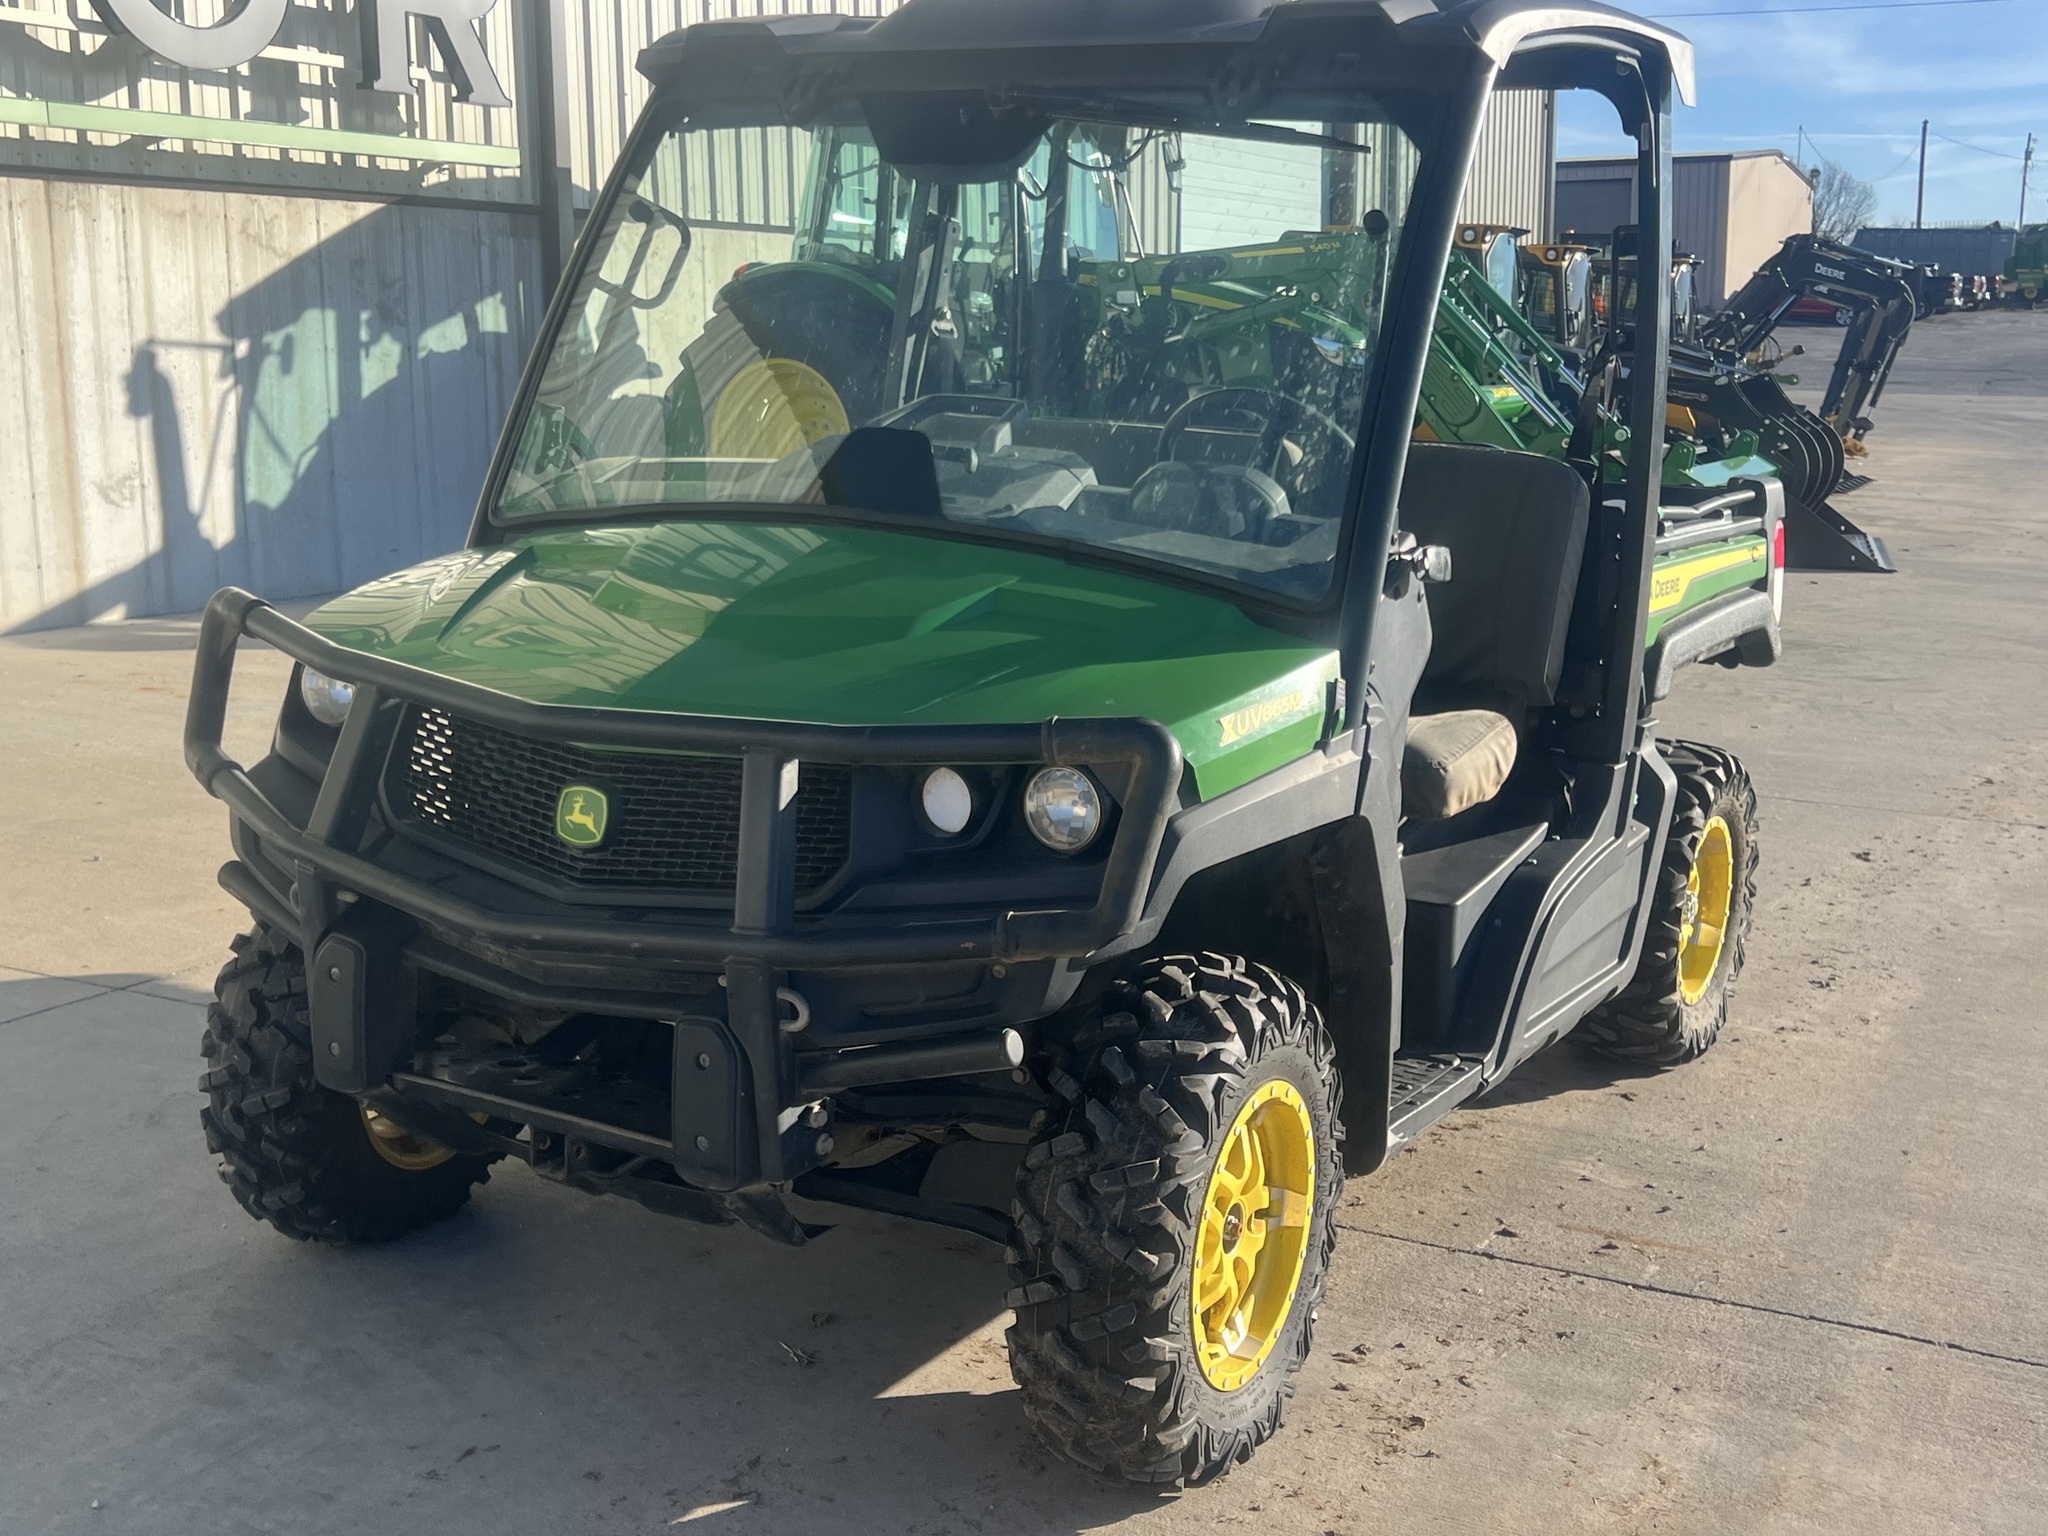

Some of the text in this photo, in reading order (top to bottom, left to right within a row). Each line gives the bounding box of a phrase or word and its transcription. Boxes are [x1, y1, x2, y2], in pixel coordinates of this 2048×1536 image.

[1814, 262, 1846, 281] DEERE
[1654, 576, 1680, 600] DEERE
[1220, 689, 1303, 746] XUV865M
